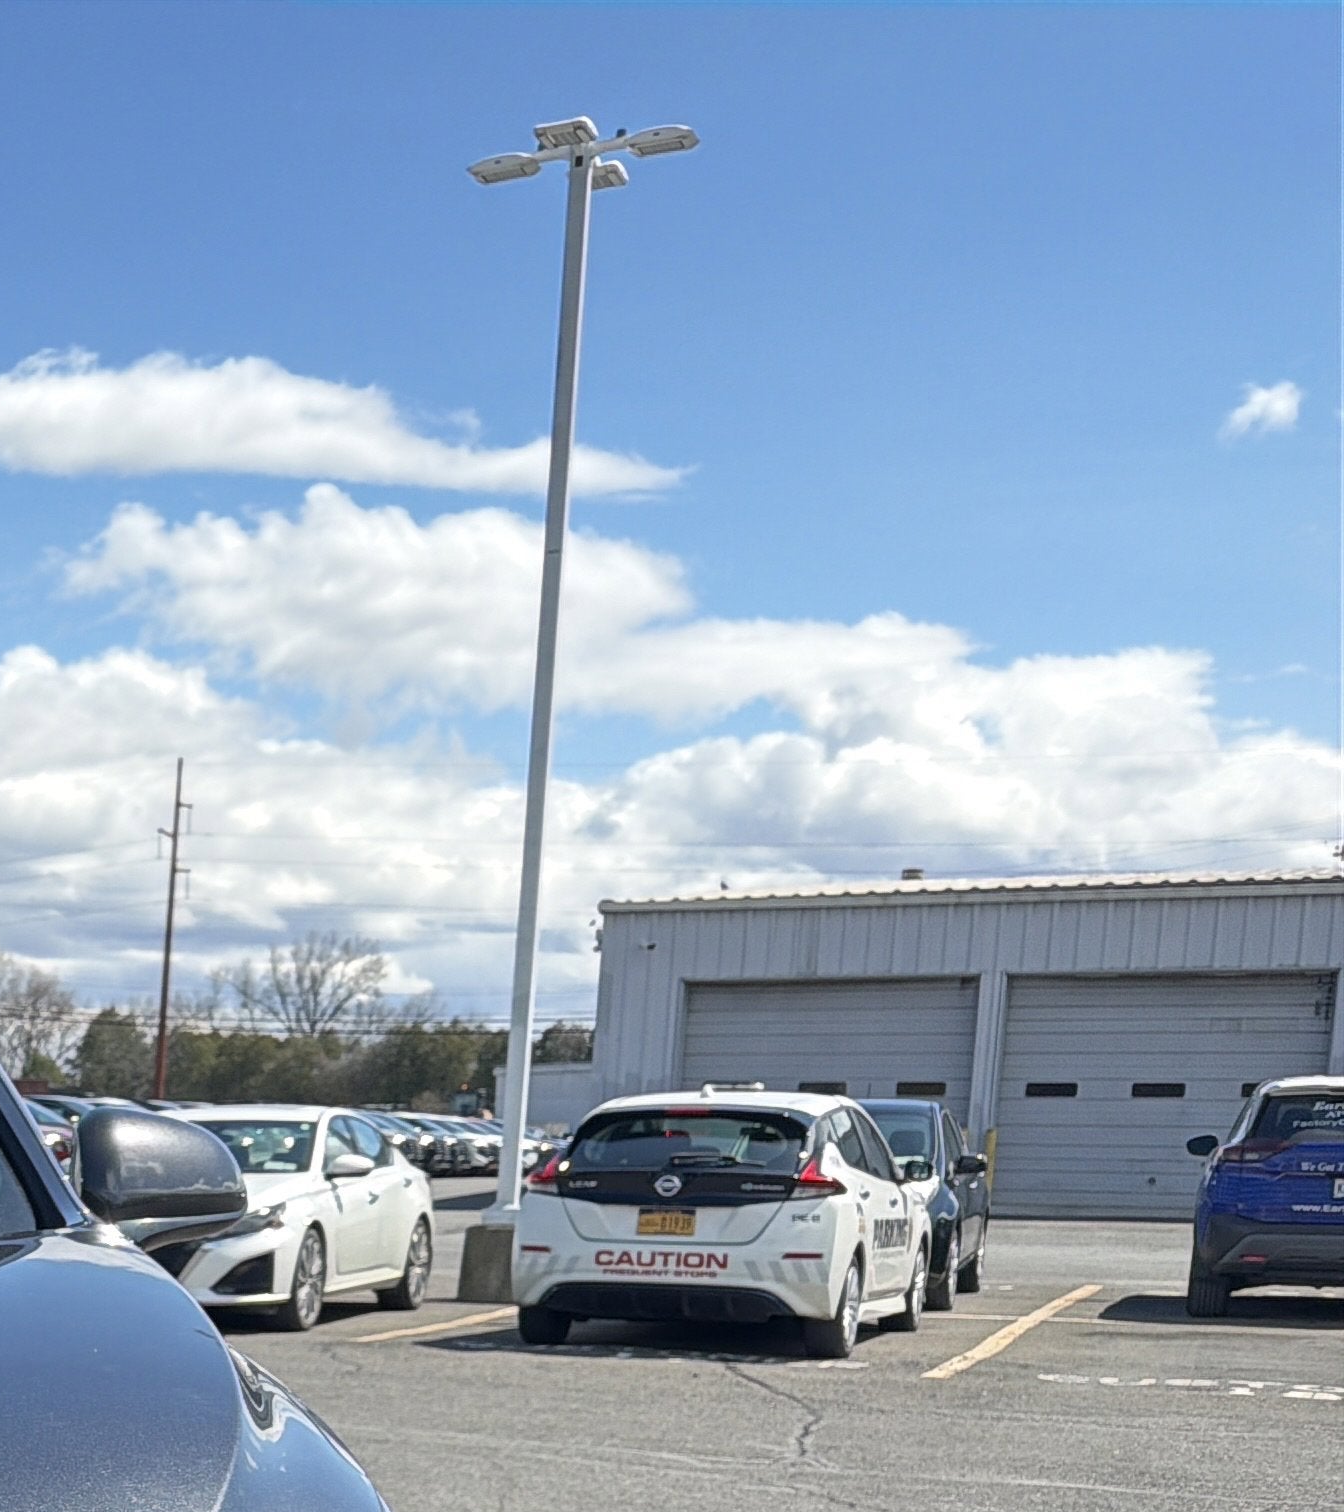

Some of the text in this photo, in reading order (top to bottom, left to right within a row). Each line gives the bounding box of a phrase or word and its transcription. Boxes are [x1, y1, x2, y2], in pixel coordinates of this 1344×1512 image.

[568, 1180, 598, 1189] LEAF
[594, 1250, 729, 1269] CAUTION
[602, 1268, 718, 1278] FREQUENT STOPS
